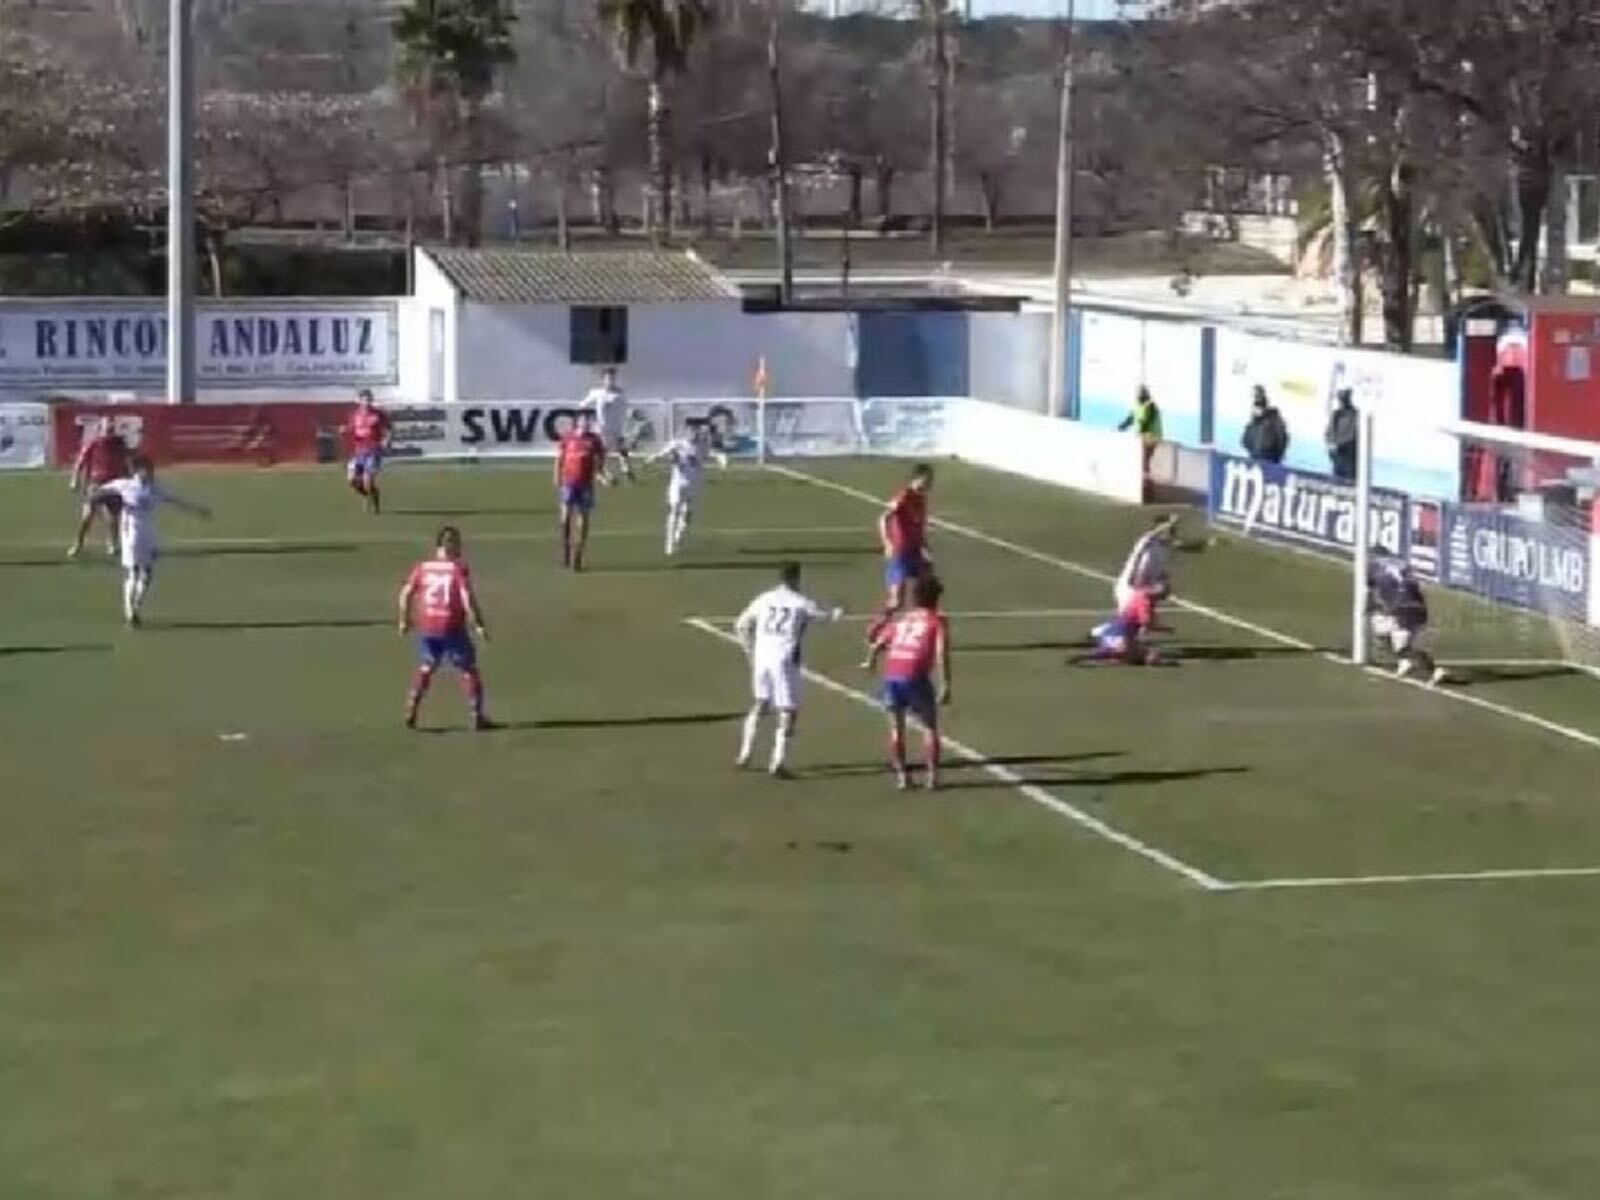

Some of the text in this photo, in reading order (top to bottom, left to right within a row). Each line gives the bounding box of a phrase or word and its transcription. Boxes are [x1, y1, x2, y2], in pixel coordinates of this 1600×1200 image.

[211, 318, 373, 357] ANDALUZ
[1473, 527, 1537, 582] GRUPO
[1538, 541, 1584, 593] LMB
[421, 573, 452, 606] 21
[765, 606, 791, 635] 22
